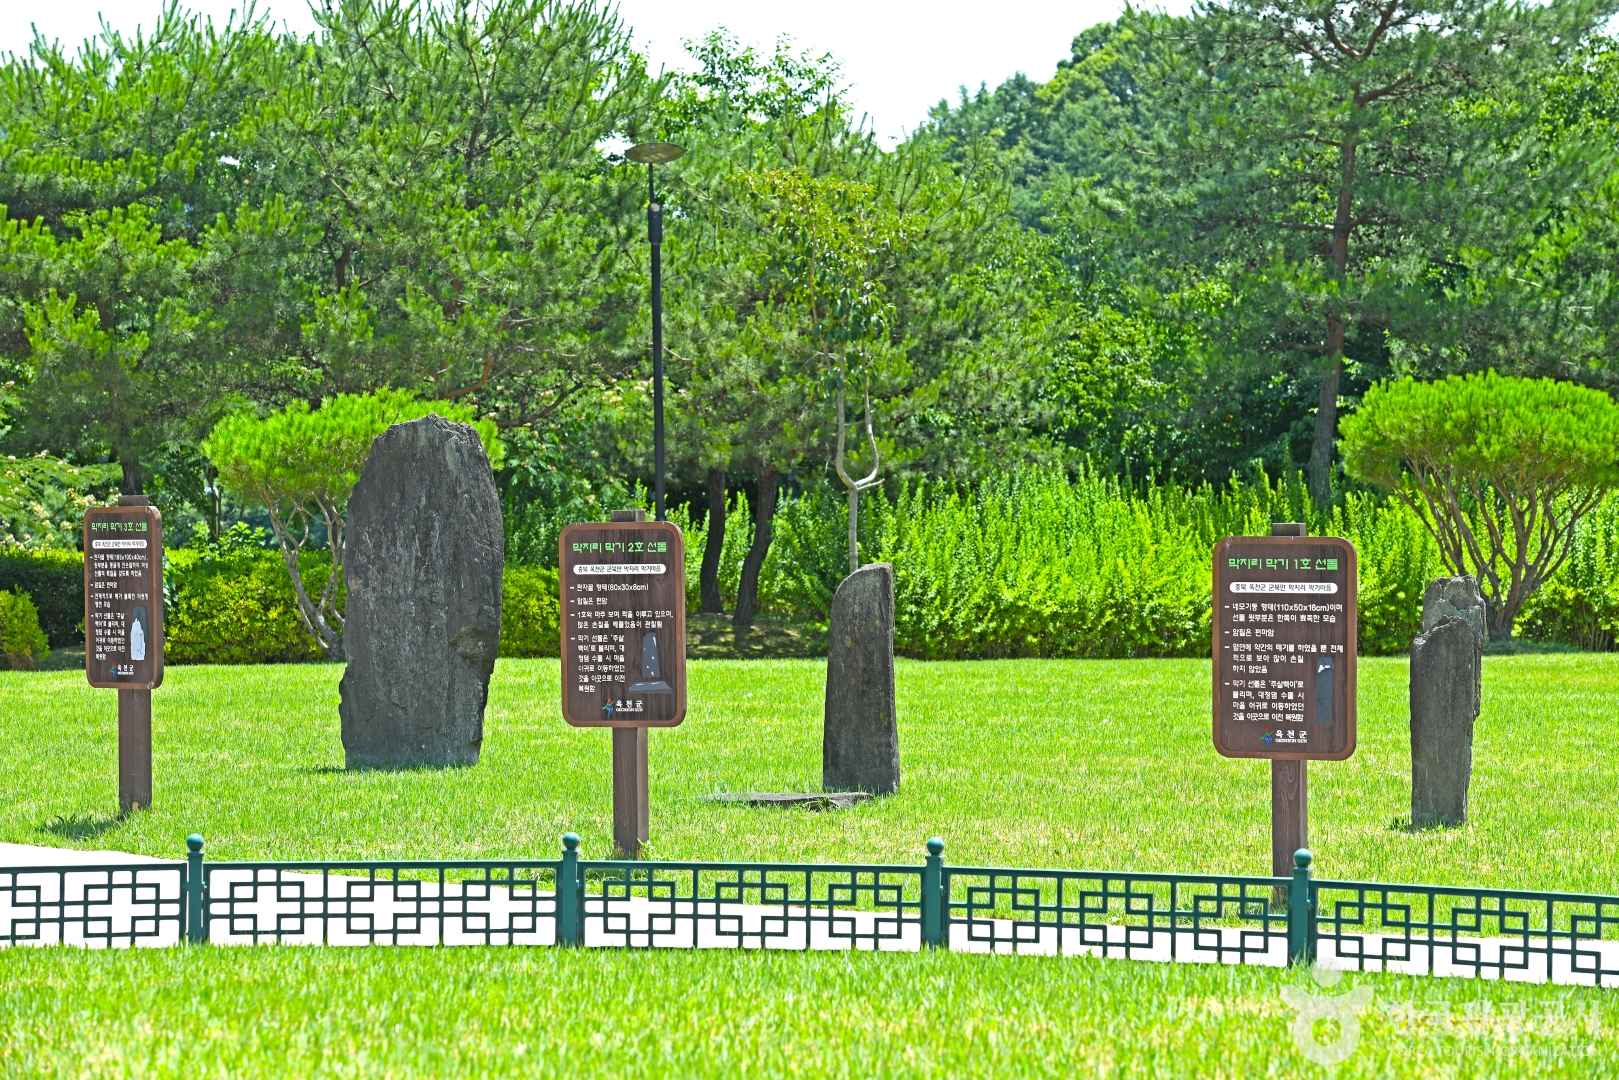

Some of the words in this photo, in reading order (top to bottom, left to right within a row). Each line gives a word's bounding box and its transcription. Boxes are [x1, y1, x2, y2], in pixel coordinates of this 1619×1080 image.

[628, 542, 644, 552] 2호
[648, 542, 667, 552] 선돌
[1228, 558, 1262, 570] 막지리
[1266, 558, 1288, 570] 막기
[1295, 558, 1312, 570] 1호
[1315, 558, 1338, 570] 선돌
[1233, 614, 1245, 623] 선돌
[1322, 614, 1336, 623] 모습
[1233, 629, 1252, 637] 암질은
[1255, 629, 1274, 637] 편마암
[1331, 644, 1343, 653] 전체
[1290, 654, 1304, 663] 손질
[1233, 665, 1245, 673] 하지
[1248, 680, 1266, 688] 선돌은
[1281, 691, 1293, 700] 수몰
[1298, 691, 1304, 700] 시
[1233, 702, 1245, 711] 마을
[1249, 702, 1268, 711] 어귀로
[1272, 702, 1304, 711] 이동하였던
[1233, 713, 1244, 722] 것을
[1247, 713, 1269, 722] 이곳으로
